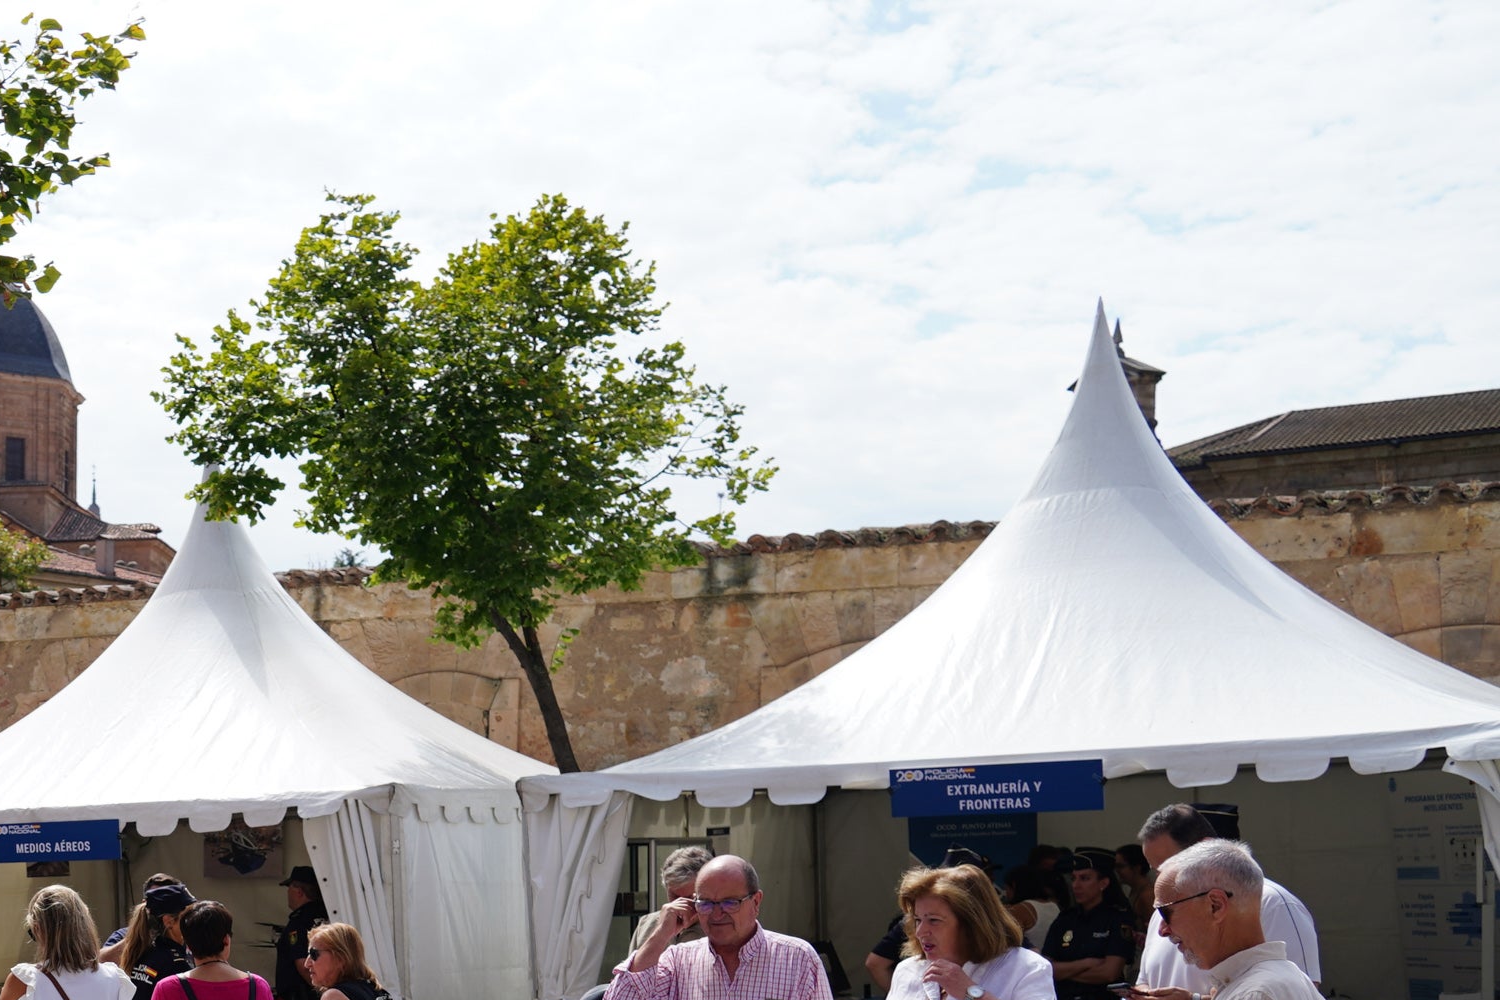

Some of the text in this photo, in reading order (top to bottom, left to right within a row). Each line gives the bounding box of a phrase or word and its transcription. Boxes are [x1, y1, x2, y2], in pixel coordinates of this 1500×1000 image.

[924, 773, 976, 781] NACIONAL
[947, 780, 1042, 796] EXTRANJERÍA Y
[1444, 792, 1477, 801] FRONTERA
[959, 797, 1031, 811] FRONTERAS
[16, 840, 91, 854] MEDIOS AÉREOS
